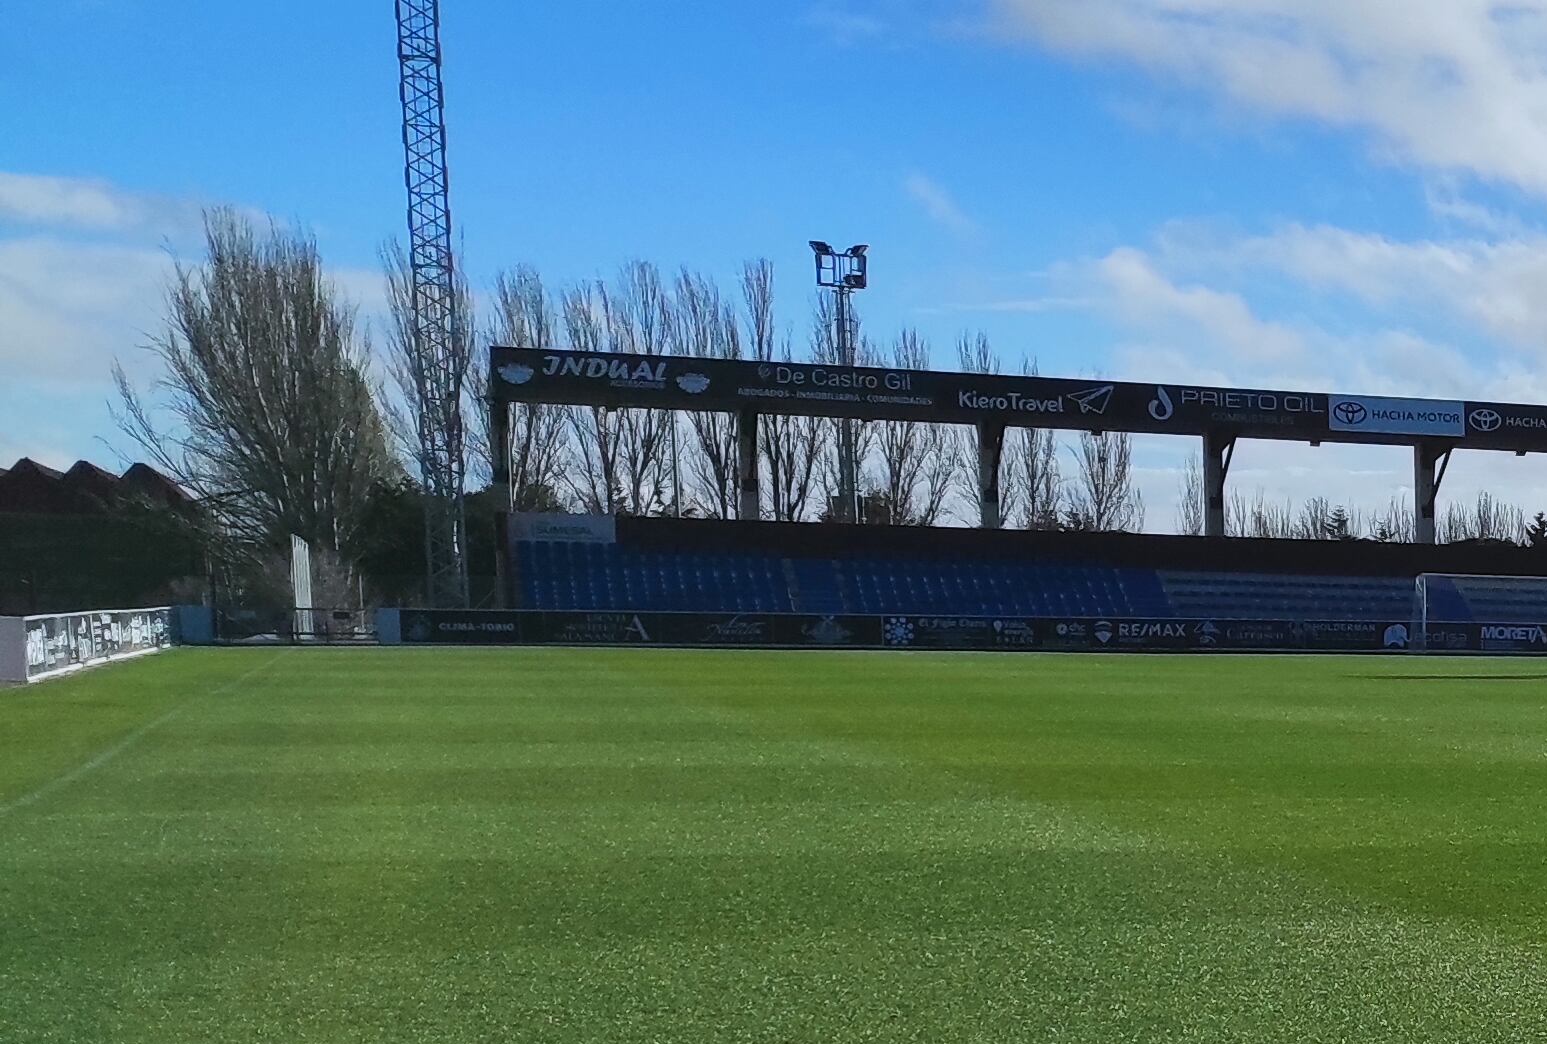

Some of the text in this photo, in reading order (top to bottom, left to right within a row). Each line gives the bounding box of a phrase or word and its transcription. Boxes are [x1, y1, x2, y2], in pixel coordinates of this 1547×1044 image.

[542, 355, 667, 382] INDUAL
[776, 366, 911, 390] De Castro Gil
[1181, 390, 1325, 413] PRIETO OIL
[1372, 408, 1460, 424] HACHA MOTOR
[1505, 415, 1547, 429] HACHA
[1118, 623, 1186, 637] RE/MAX
[1480, 626, 1547, 644] MORETA
